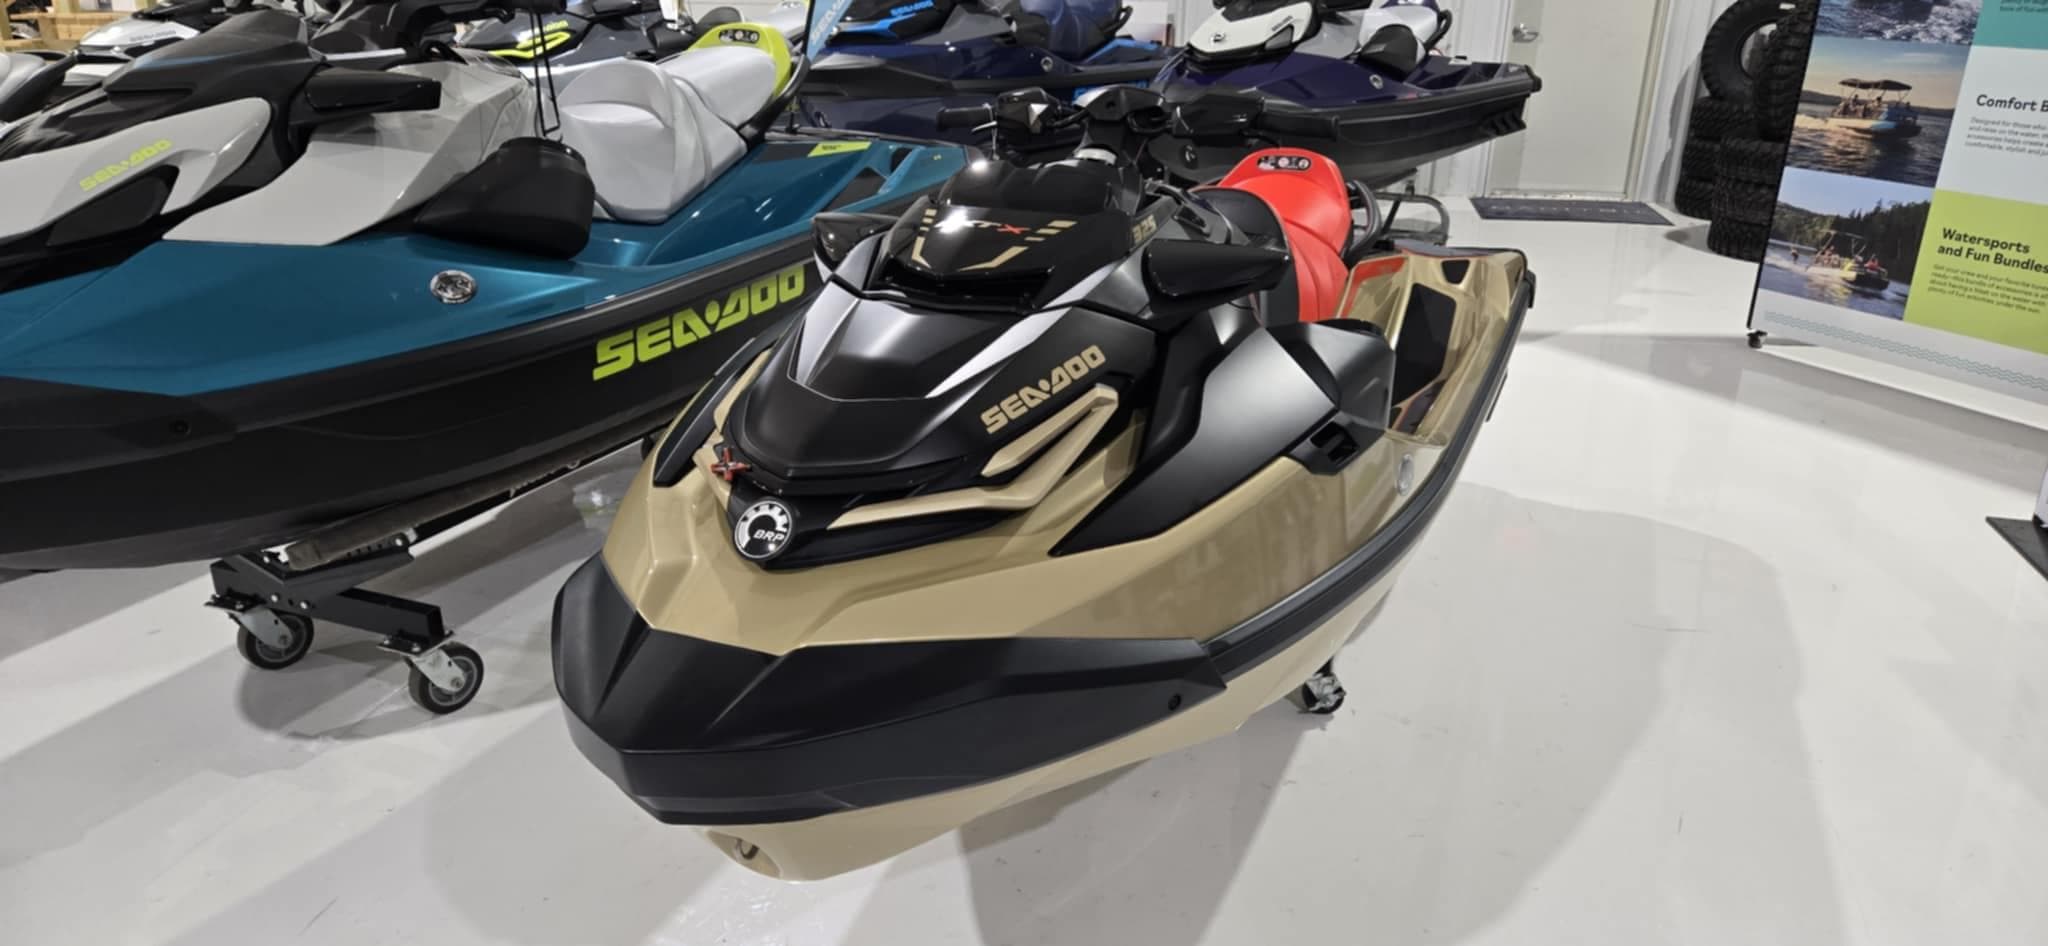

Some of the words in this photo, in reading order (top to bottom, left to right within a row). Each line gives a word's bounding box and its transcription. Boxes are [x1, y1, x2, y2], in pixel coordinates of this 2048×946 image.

[1976, 94, 2038, 111] Comfort
[1132, 214, 1156, 246] 325
[1943, 227, 2030, 254] Watersports
[1937, 245, 1963, 257] and
[1965, 247, 1990, 263] Fun
[753, 529, 785, 542] BRP
